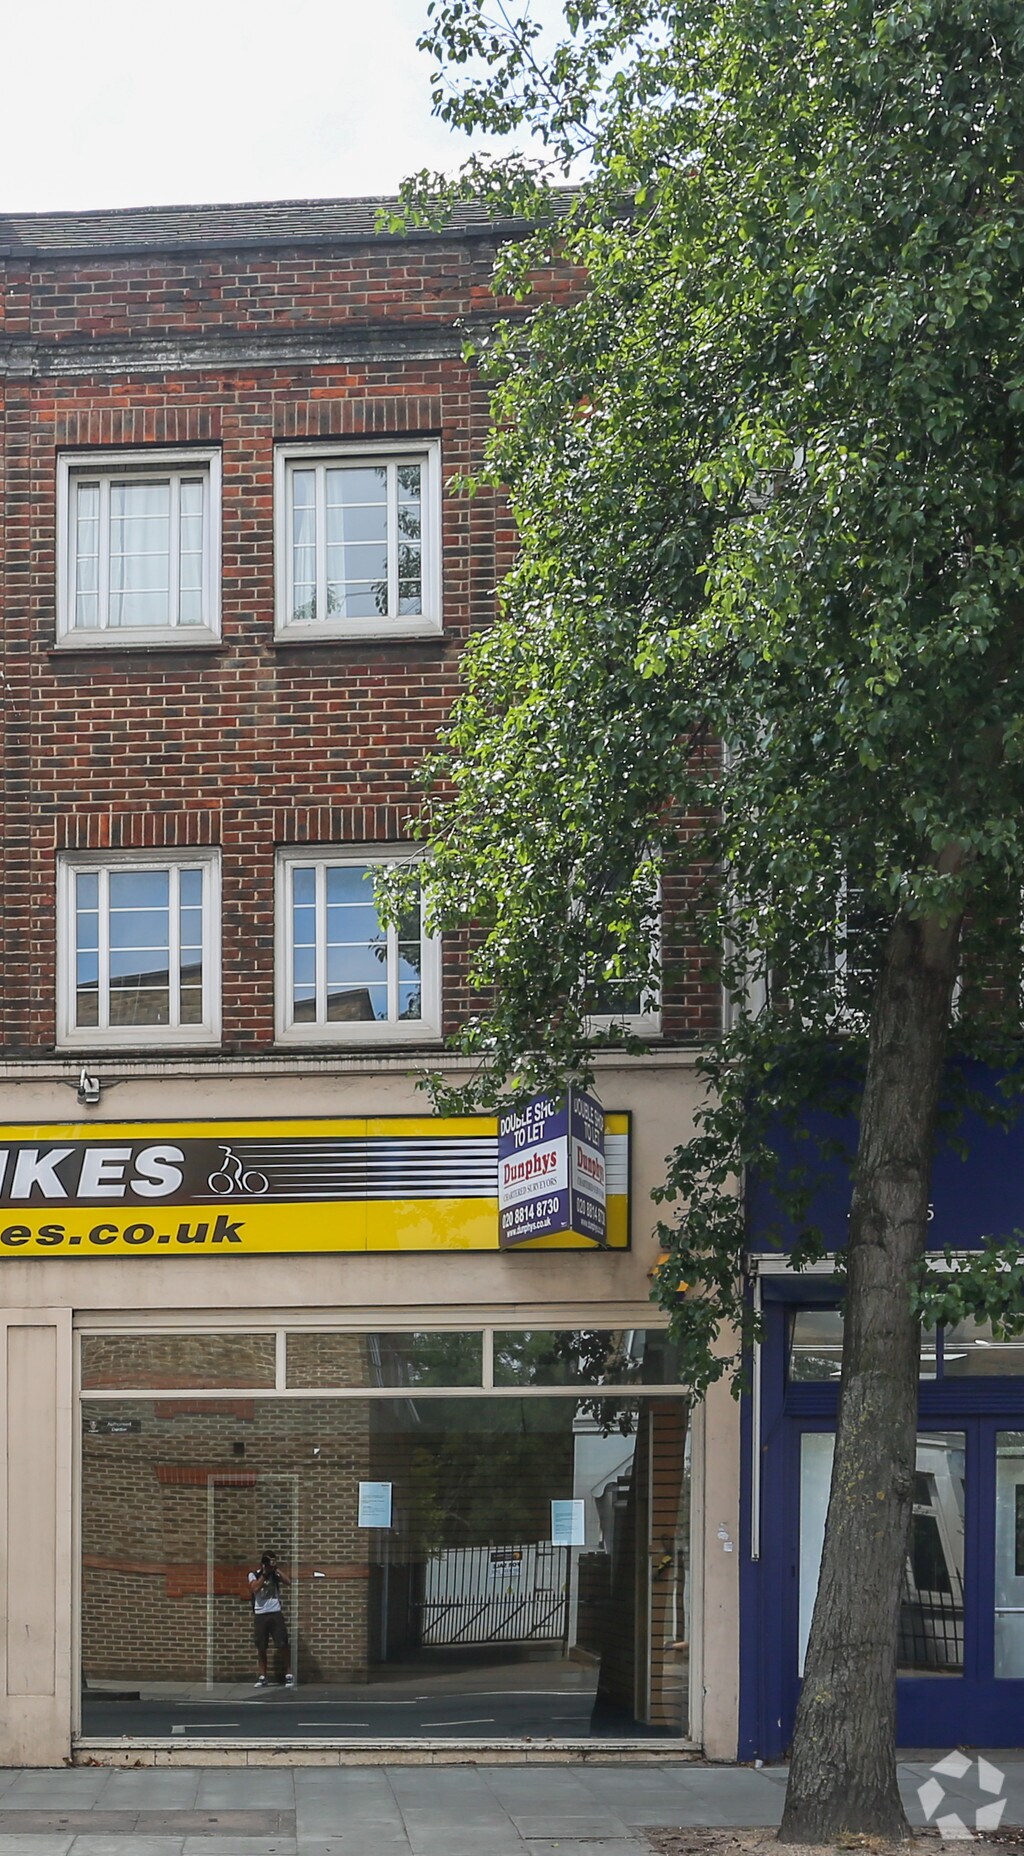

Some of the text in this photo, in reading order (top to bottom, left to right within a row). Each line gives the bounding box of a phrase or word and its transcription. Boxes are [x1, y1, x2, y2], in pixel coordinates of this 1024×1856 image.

[500, 1105, 533, 1137] DOUBLE
[573, 1098, 594, 1124] DOUBLE
[514, 1120, 545, 1148] TO LET
[584, 1120, 601, 1147] TO LET
[503, 1151, 557, 1185] Dunphys
[527, 1176, 558, 1194] SURVEYORS
[502, 1197, 559, 1229] 020 8814 8730
[576, 1197, 586, 1216] 020
[506, 1216, 551, 1238] www.dunphys.co.uk
